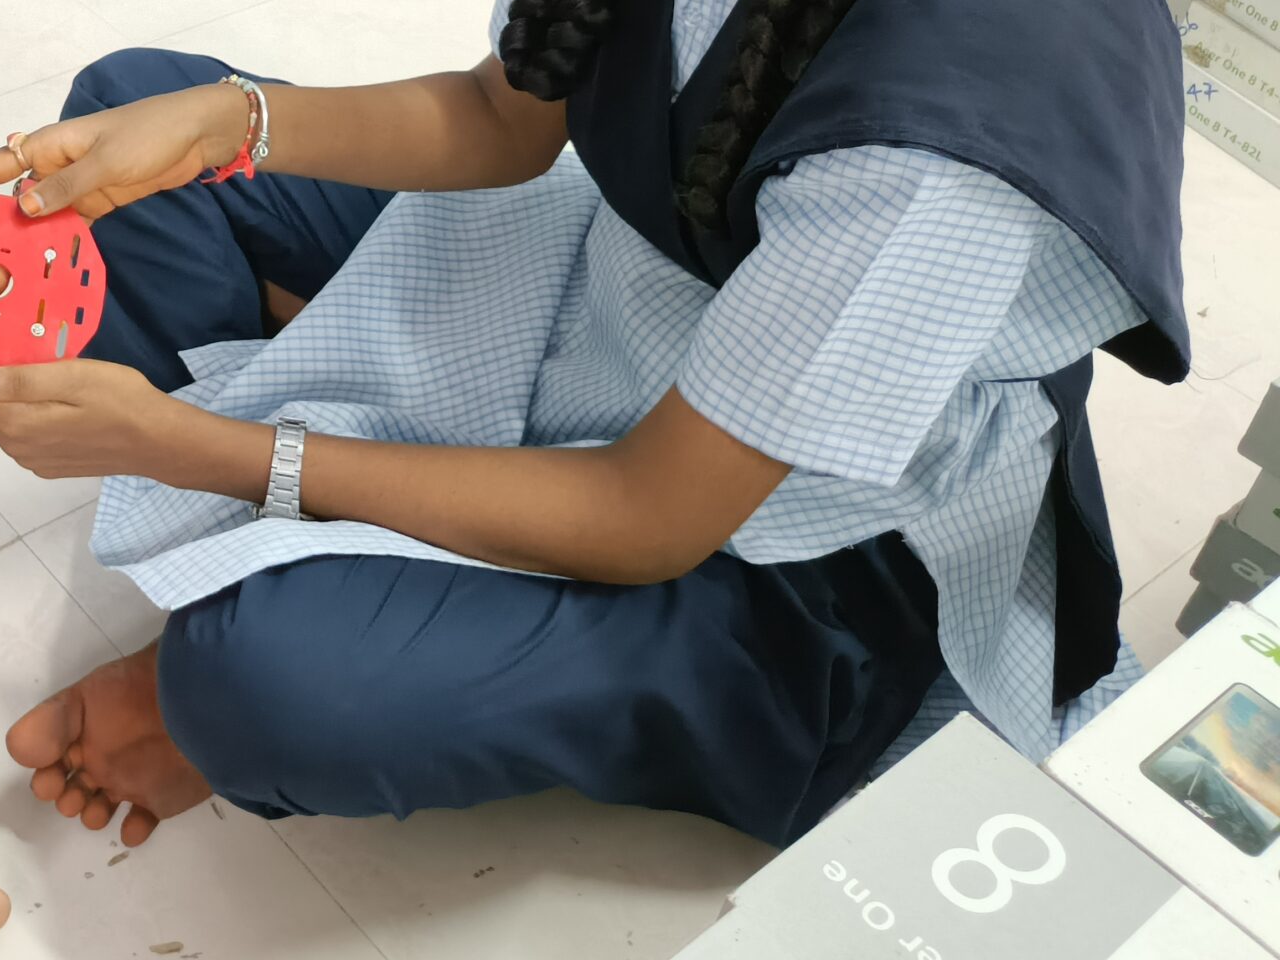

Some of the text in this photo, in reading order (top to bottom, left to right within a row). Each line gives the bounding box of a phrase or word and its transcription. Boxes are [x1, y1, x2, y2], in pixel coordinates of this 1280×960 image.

[1246, 4, 1268, 25] One
[1270, 20, 1279, 32] 8
[1186, 82, 1219, 102] 47
[1195, 41, 1280, 103] Acer One 8 T4-
[1188, 105, 1261, 162] One 8 T4-82L
[931, 813, 1067, 914] 8
[822, 860, 896, 931] One
